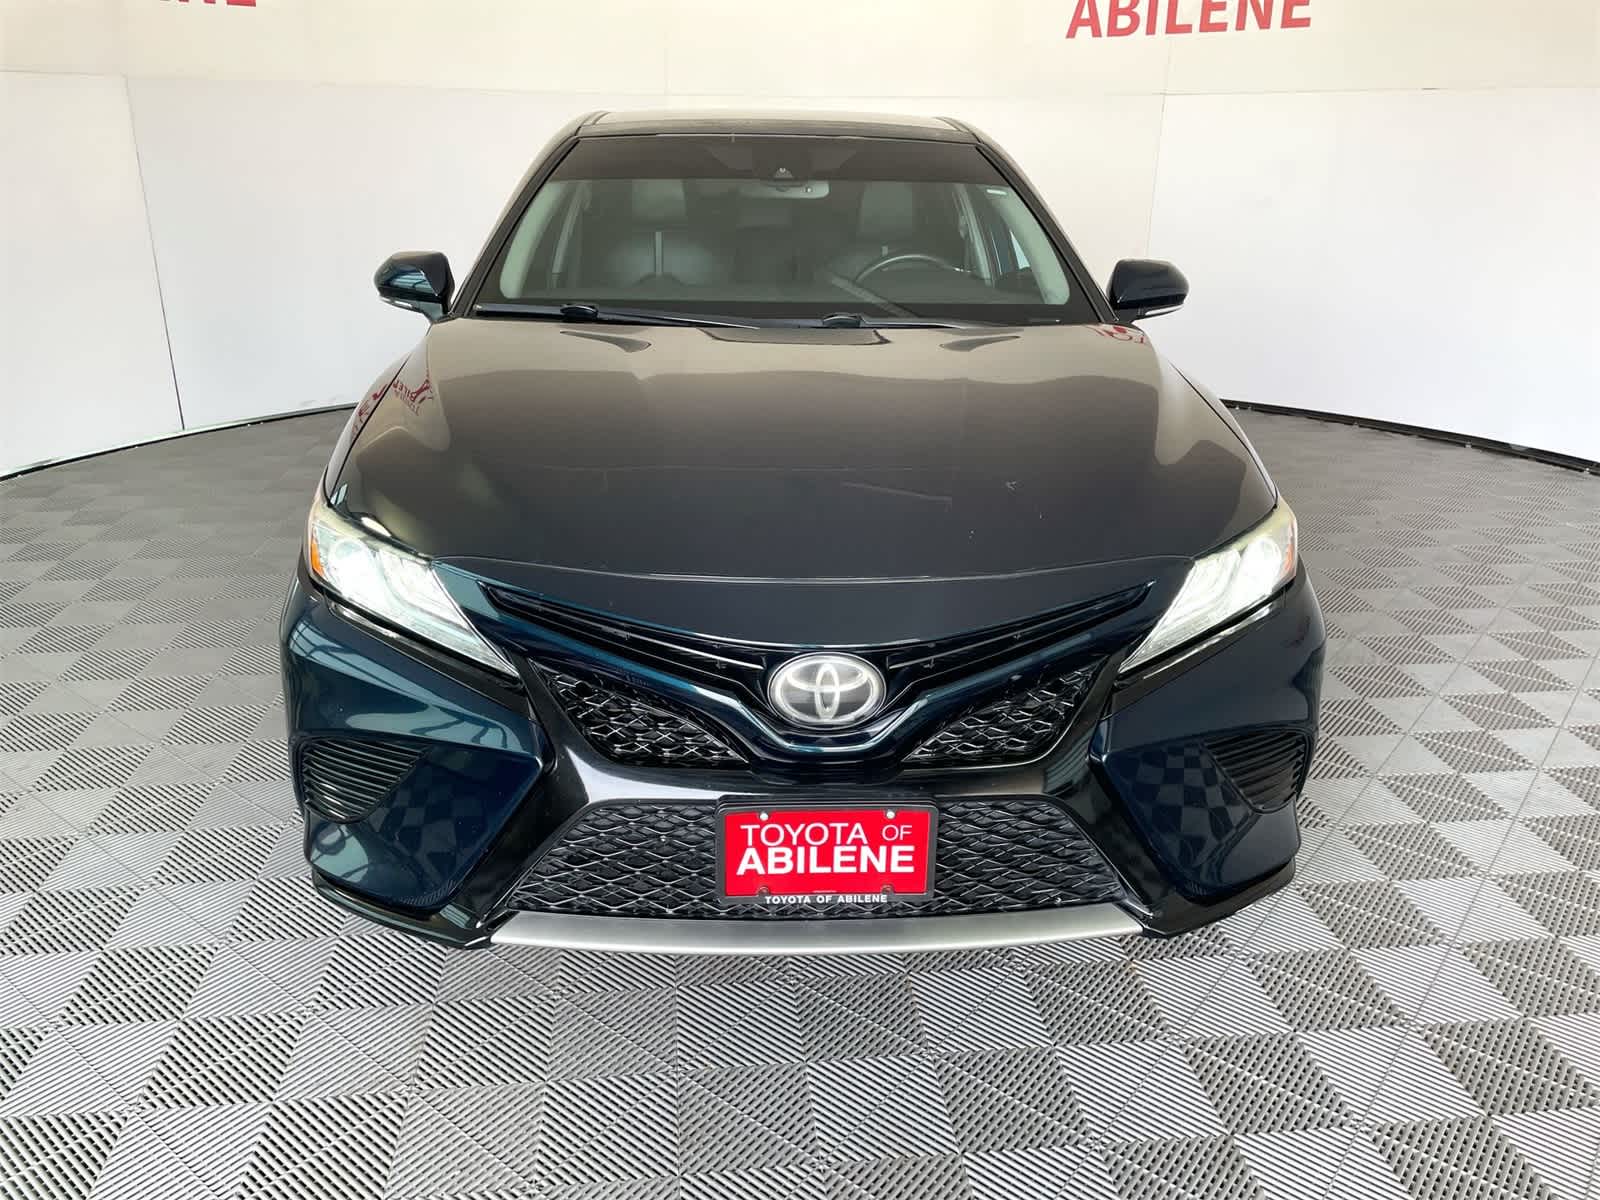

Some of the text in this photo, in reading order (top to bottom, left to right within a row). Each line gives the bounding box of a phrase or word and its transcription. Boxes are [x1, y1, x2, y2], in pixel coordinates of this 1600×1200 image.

[1065, 0, 1312, 38] ABILENE
[740, 823, 913, 846] TOYOTA OF
[736, 845, 915, 876] ABILENE
[765, 894, 888, 905] TOYOTA OF ABILENE
